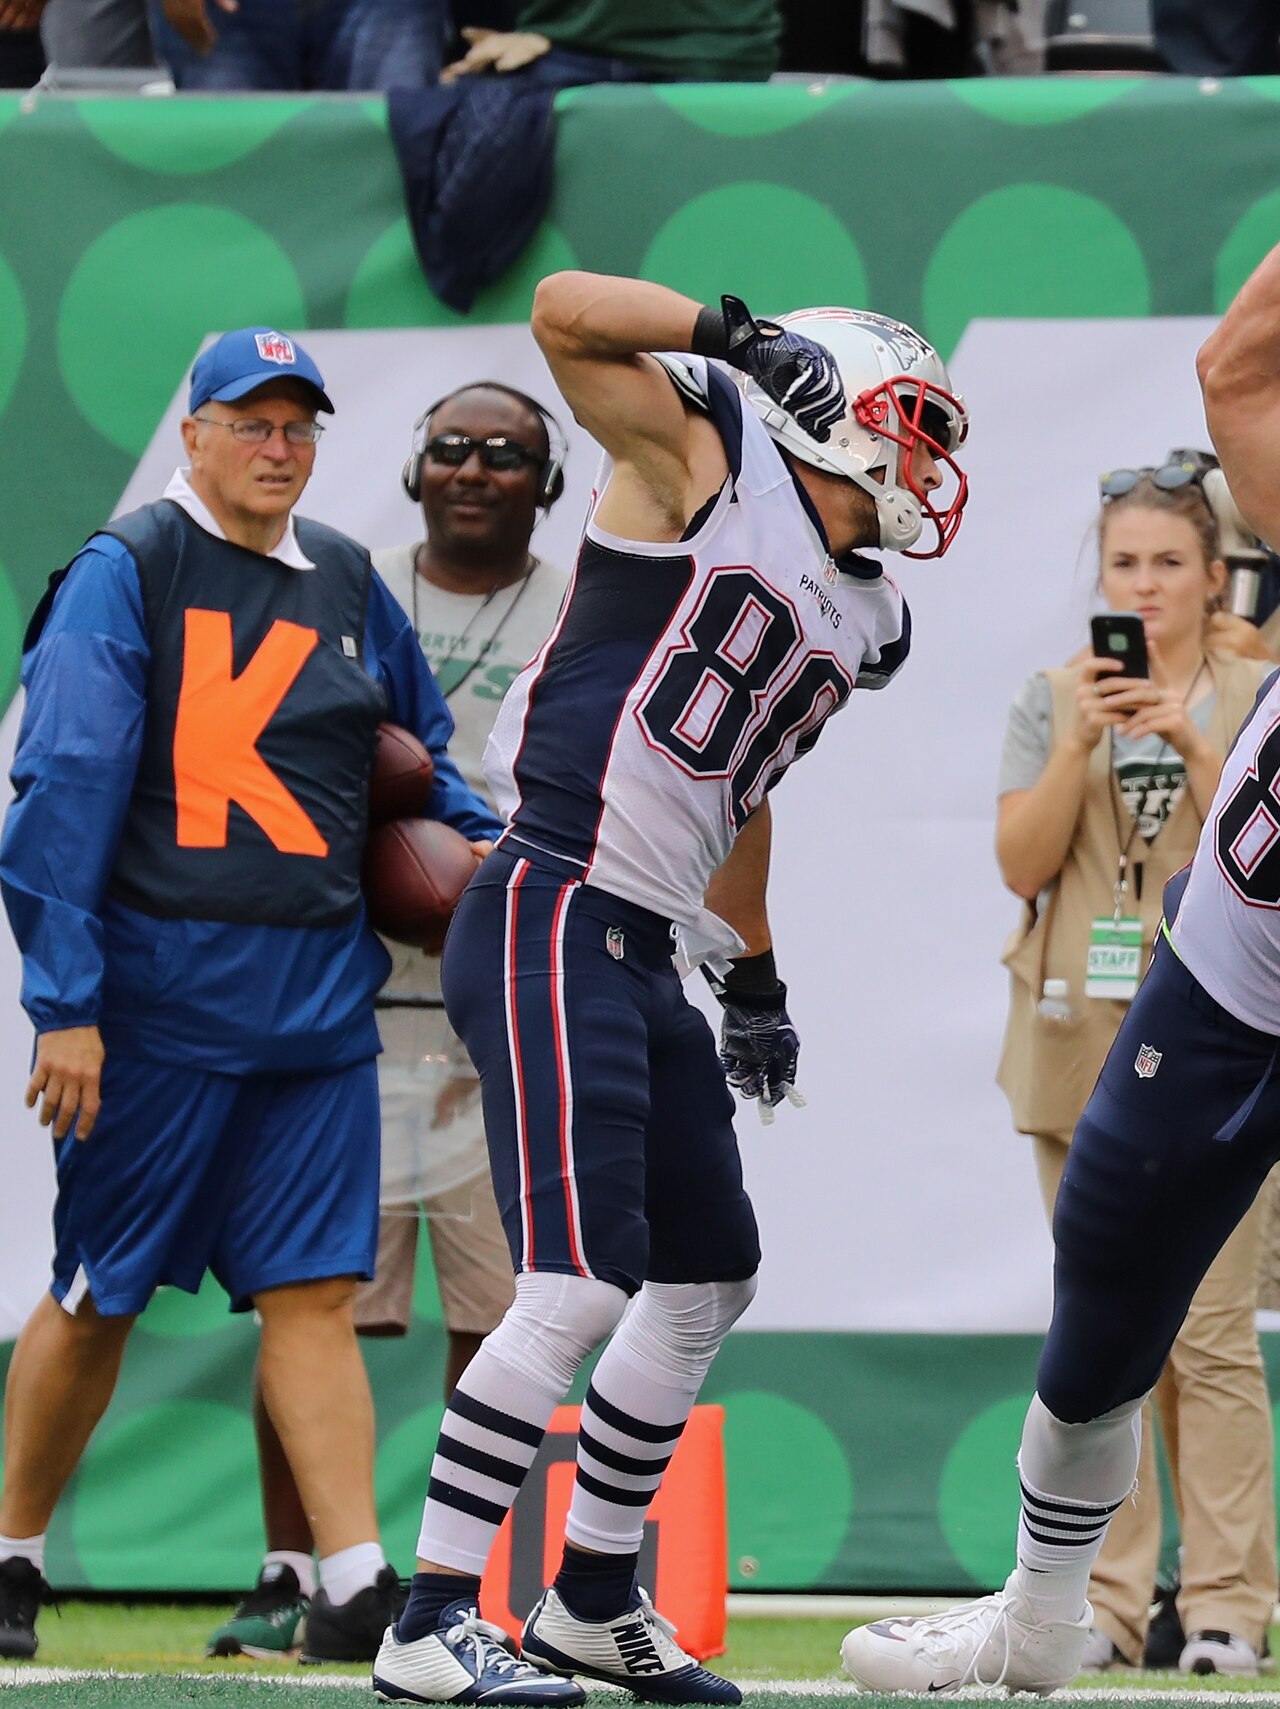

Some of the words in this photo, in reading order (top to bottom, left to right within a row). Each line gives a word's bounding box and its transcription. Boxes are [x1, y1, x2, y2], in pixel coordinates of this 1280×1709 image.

[799, 574, 842, 629] PATRIOTS
[633, 566, 855, 834] 80
[173, 607, 330, 858] K
[1089, 951, 1138, 968] STAFF
[610, 1620, 666, 1675] NIKE
